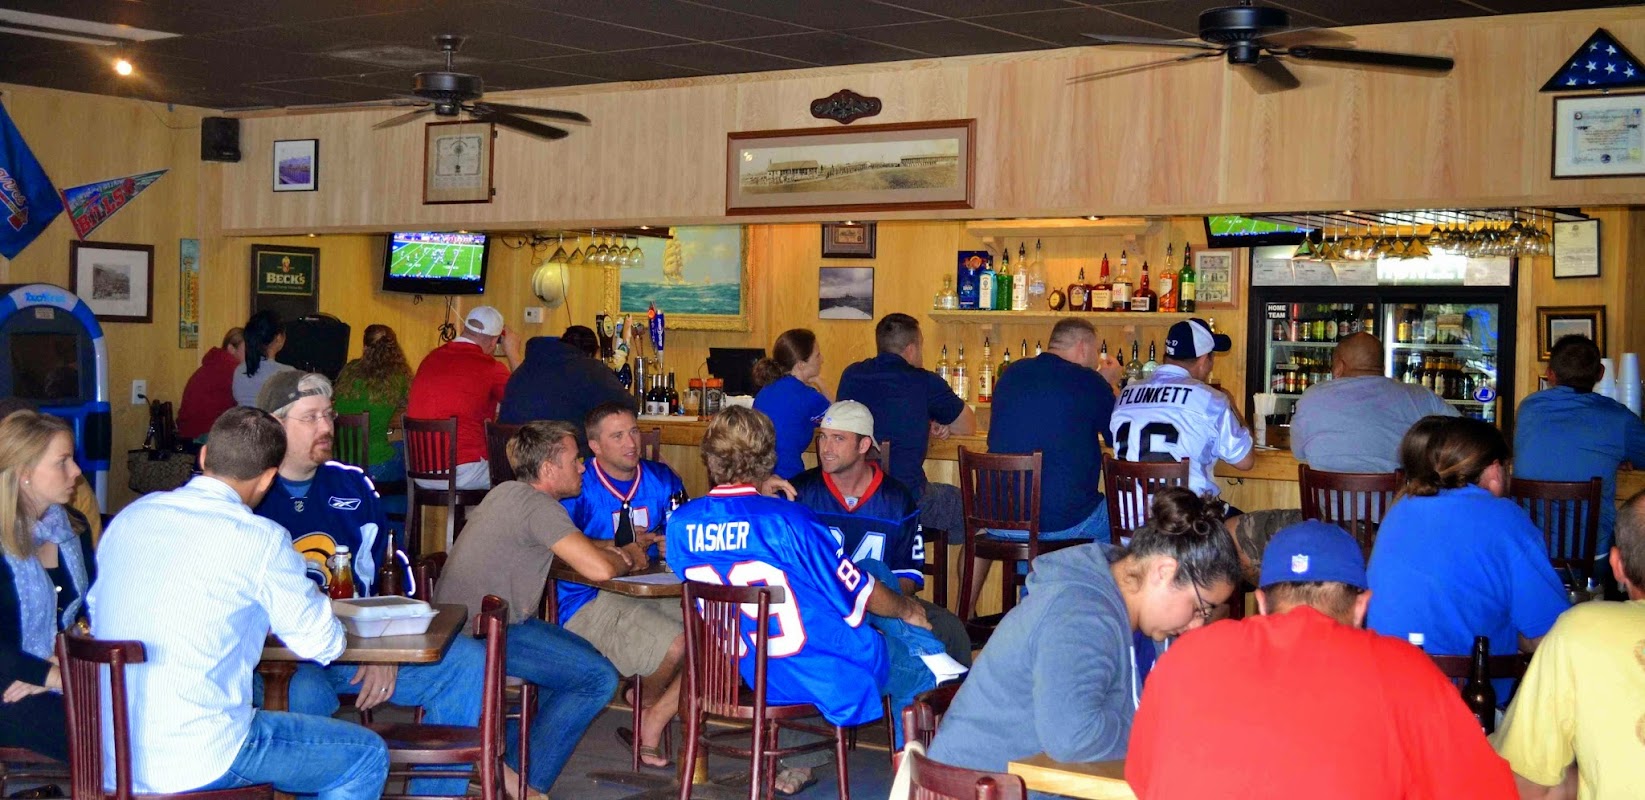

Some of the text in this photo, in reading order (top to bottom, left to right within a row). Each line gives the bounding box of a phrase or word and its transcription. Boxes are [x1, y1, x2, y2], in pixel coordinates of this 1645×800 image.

[1119, 386, 1193, 406] PLUNKETT
[1115, 421, 1180, 463] 16
[686, 521, 750, 552] TASKER
[836, 558, 861, 592] 8
